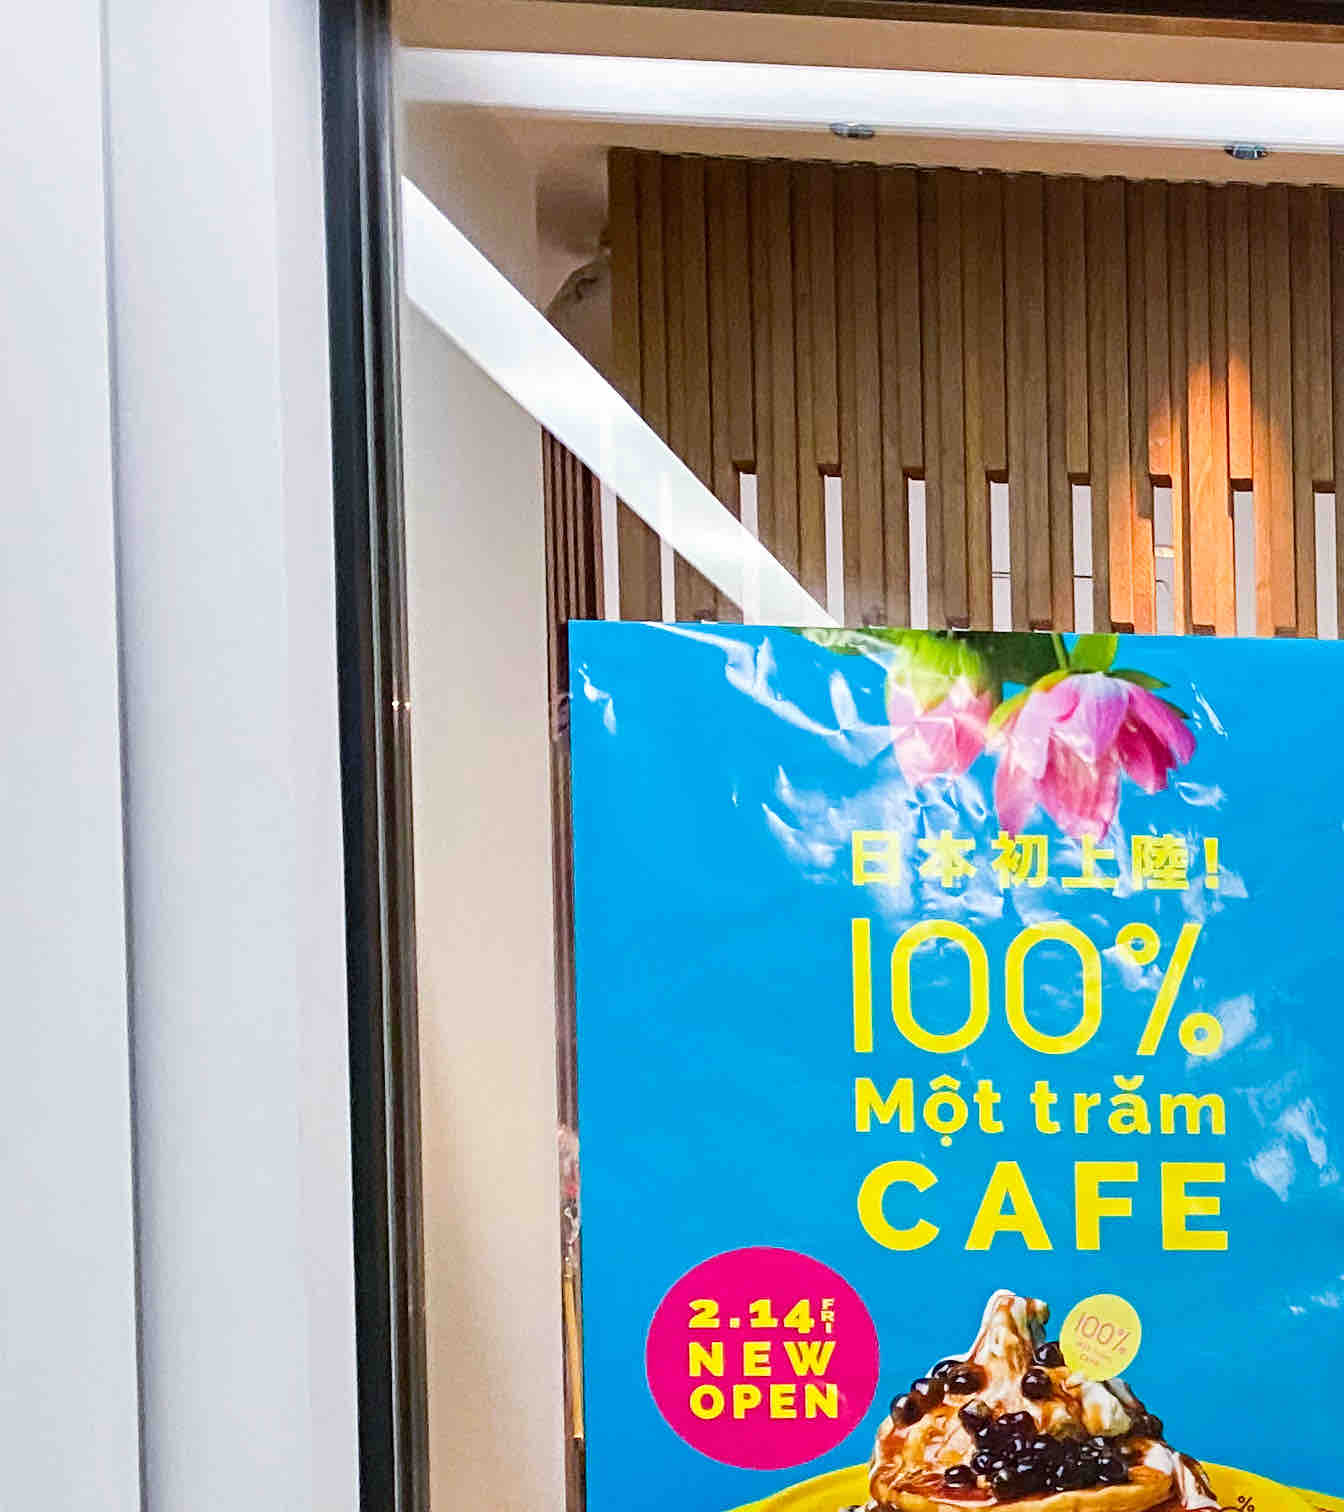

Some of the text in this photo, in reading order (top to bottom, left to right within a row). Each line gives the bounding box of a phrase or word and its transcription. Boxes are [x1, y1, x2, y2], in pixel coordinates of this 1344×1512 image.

[851, 917, 1224, 1056] 100%
[854, 1073, 1227, 1147] Một trăm
[857, 1160, 1229, 1251] CAFE
[688, 1298, 815, 1334] 2.14
[688, 1341, 837, 1377] NEW
[689, 1383, 839, 1420] OPEN
